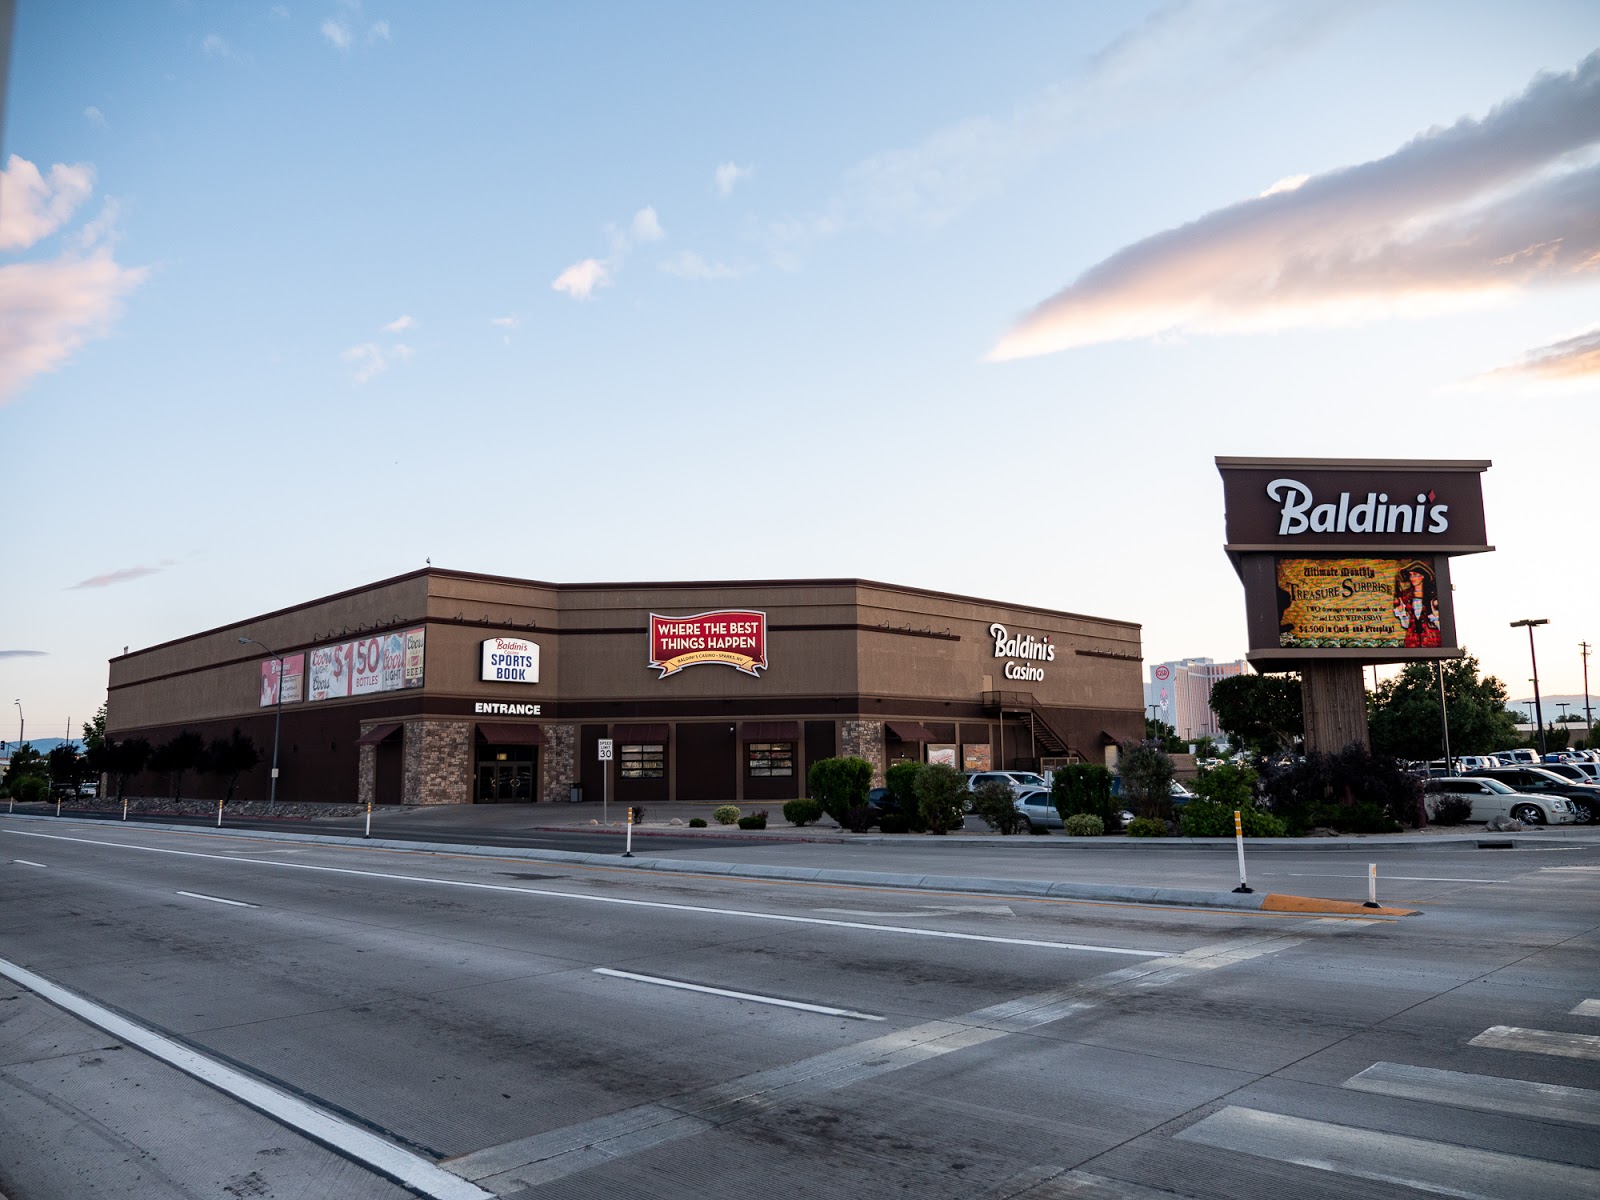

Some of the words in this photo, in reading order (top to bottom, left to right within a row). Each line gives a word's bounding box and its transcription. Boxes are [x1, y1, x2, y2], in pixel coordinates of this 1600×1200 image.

[1266, 478, 1449, 535] Baldini's
[1304, 566, 1338, 577] Ultimate
[1340, 566, 1375, 579] Monthly
[658, 623, 701, 635] WHERE
[703, 622, 727, 635] THE
[730, 621, 759, 634] BEST
[496, 637, 528, 651] Baldini's
[661, 637, 706, 650] THINGS
[708, 636, 756, 649] HAPPEN
[990, 623, 1055, 661] Baldini's
[491, 653, 533, 668] SPORTS
[384, 669, 401, 682] LIGHT
[496, 667, 526, 681] BOOK
[1004, 661, 1045, 681] Casino
[355, 675, 379, 688] BOTTLES
[475, 702, 541, 715] ENTRANCE
[600, 749, 612, 758] 30
